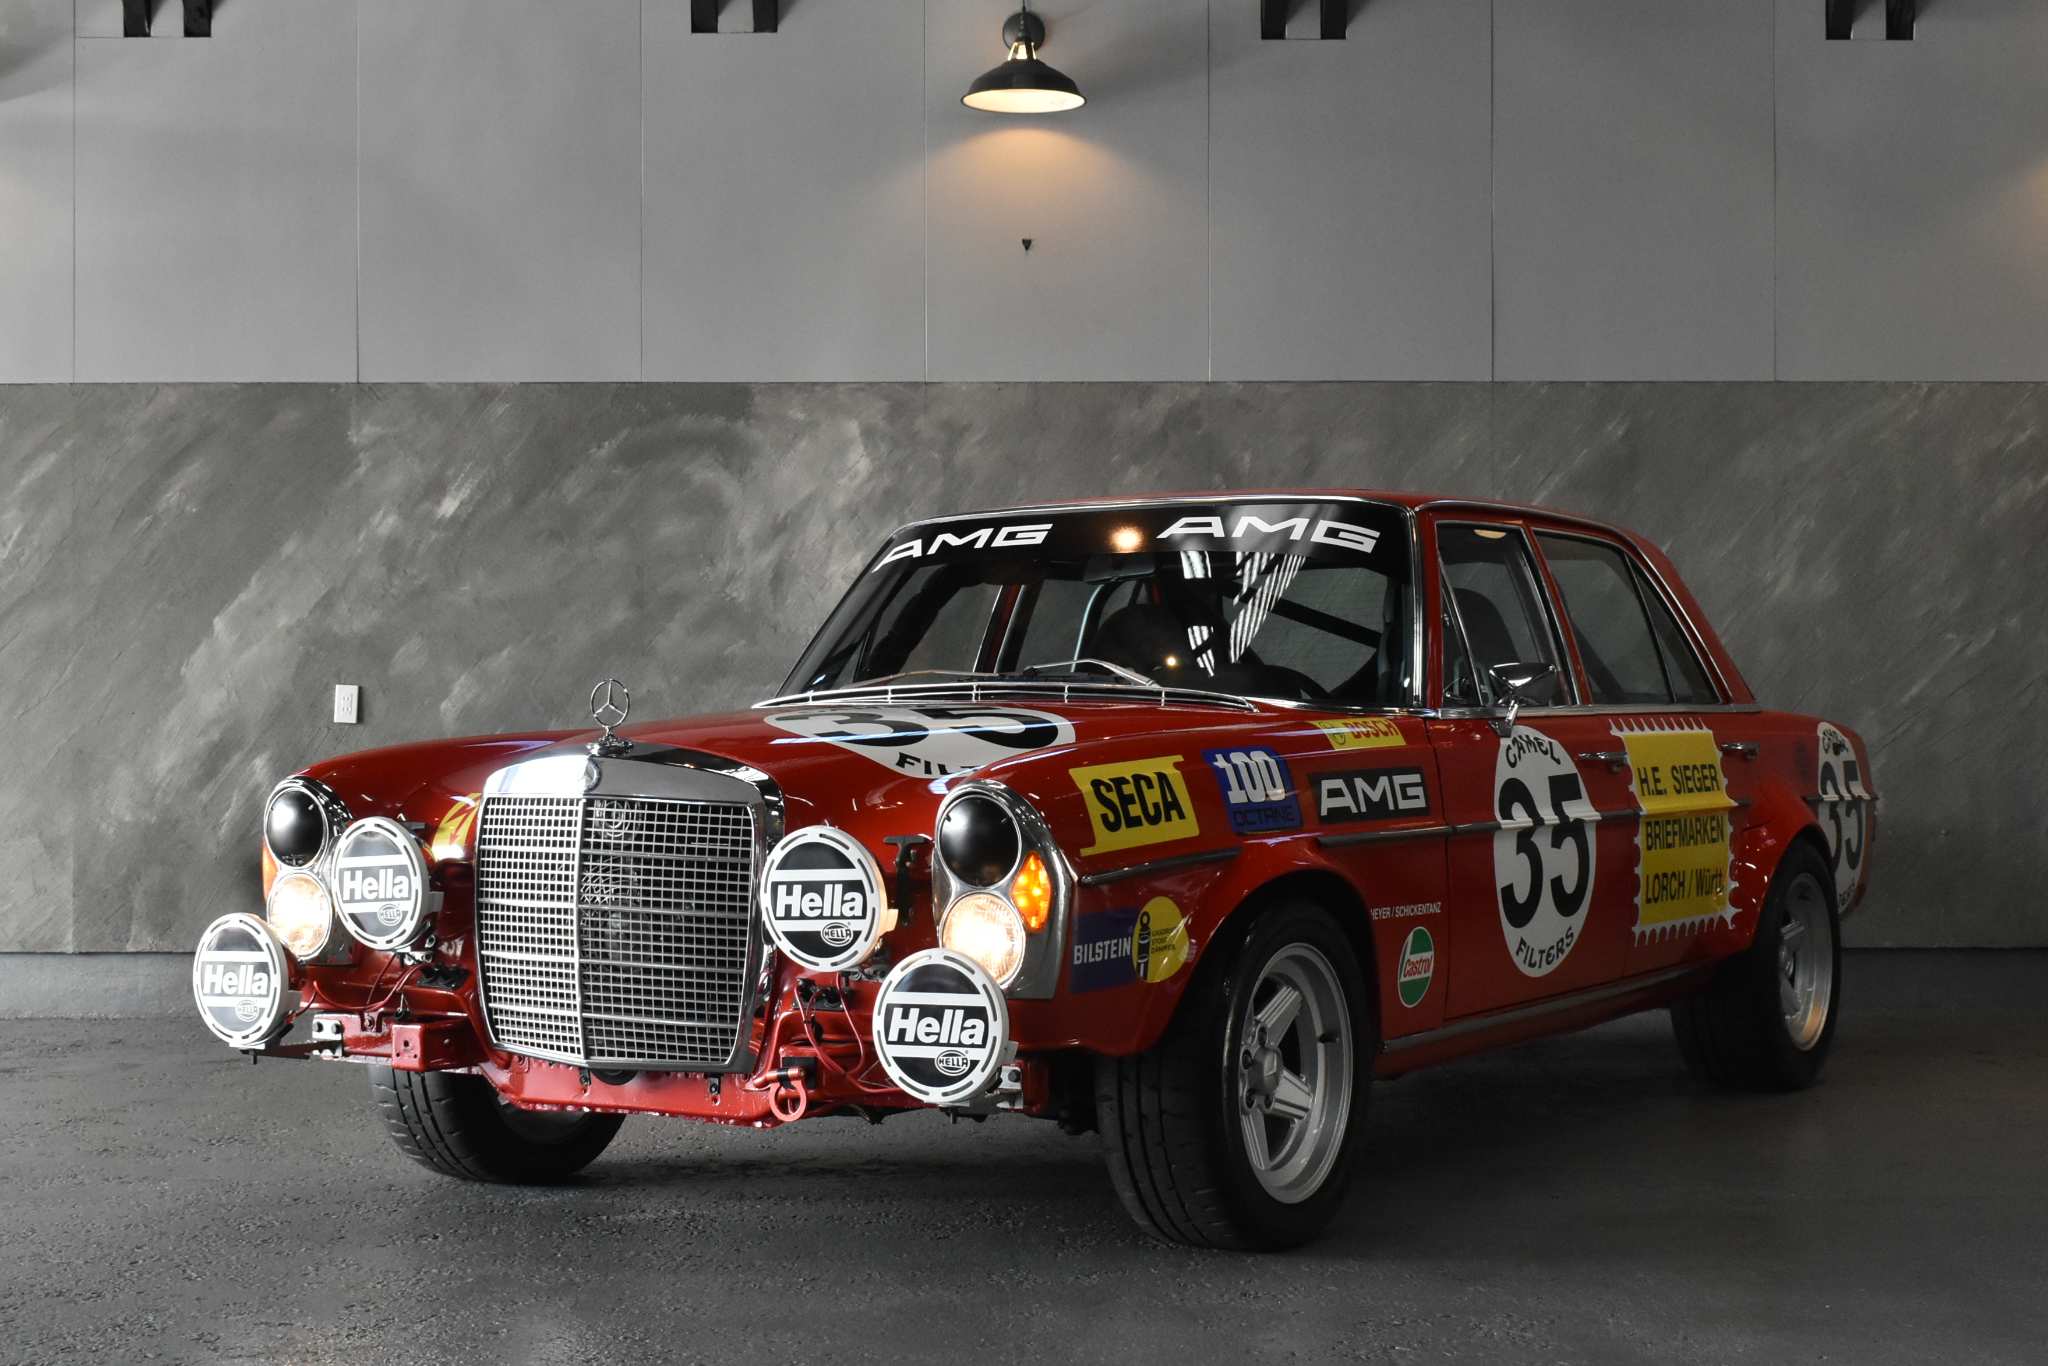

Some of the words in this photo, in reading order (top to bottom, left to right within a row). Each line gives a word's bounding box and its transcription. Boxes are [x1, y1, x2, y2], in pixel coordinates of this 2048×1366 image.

[872, 523, 1053, 574] AMG
[1156, 516, 1382, 554] AMG
[776, 706, 1059, 749] 35
[1506, 734, 1562, 768] CAMEL
[1213, 751, 1286, 804] 100
[1320, 774, 1425, 816] AMG
[1637, 766, 1667, 796] H.E.
[1670, 764, 1721, 794] SIEGER
[1090, 770, 1186, 832] SECA
[1500, 772, 1591, 929] 35
[1646, 816, 1725, 851] BRIEFMARKEN
[343, 869, 409, 900] Hella
[776, 883, 864, 918] Hella
[1646, 870, 1686, 904] LORCH
[1396, 902, 1442, 918] SCHICKENTANZ
[823, 928, 851, 939] HELLA
[1073, 936, 1132, 965] BILSTEIN
[1516, 925, 1574, 969] FILTERS
[203, 964, 269, 996] Hella
[1404, 955, 1433, 977] Castrol
[888, 1007, 986, 1045] Hella
[938, 1057, 970, 1069] HELLA
